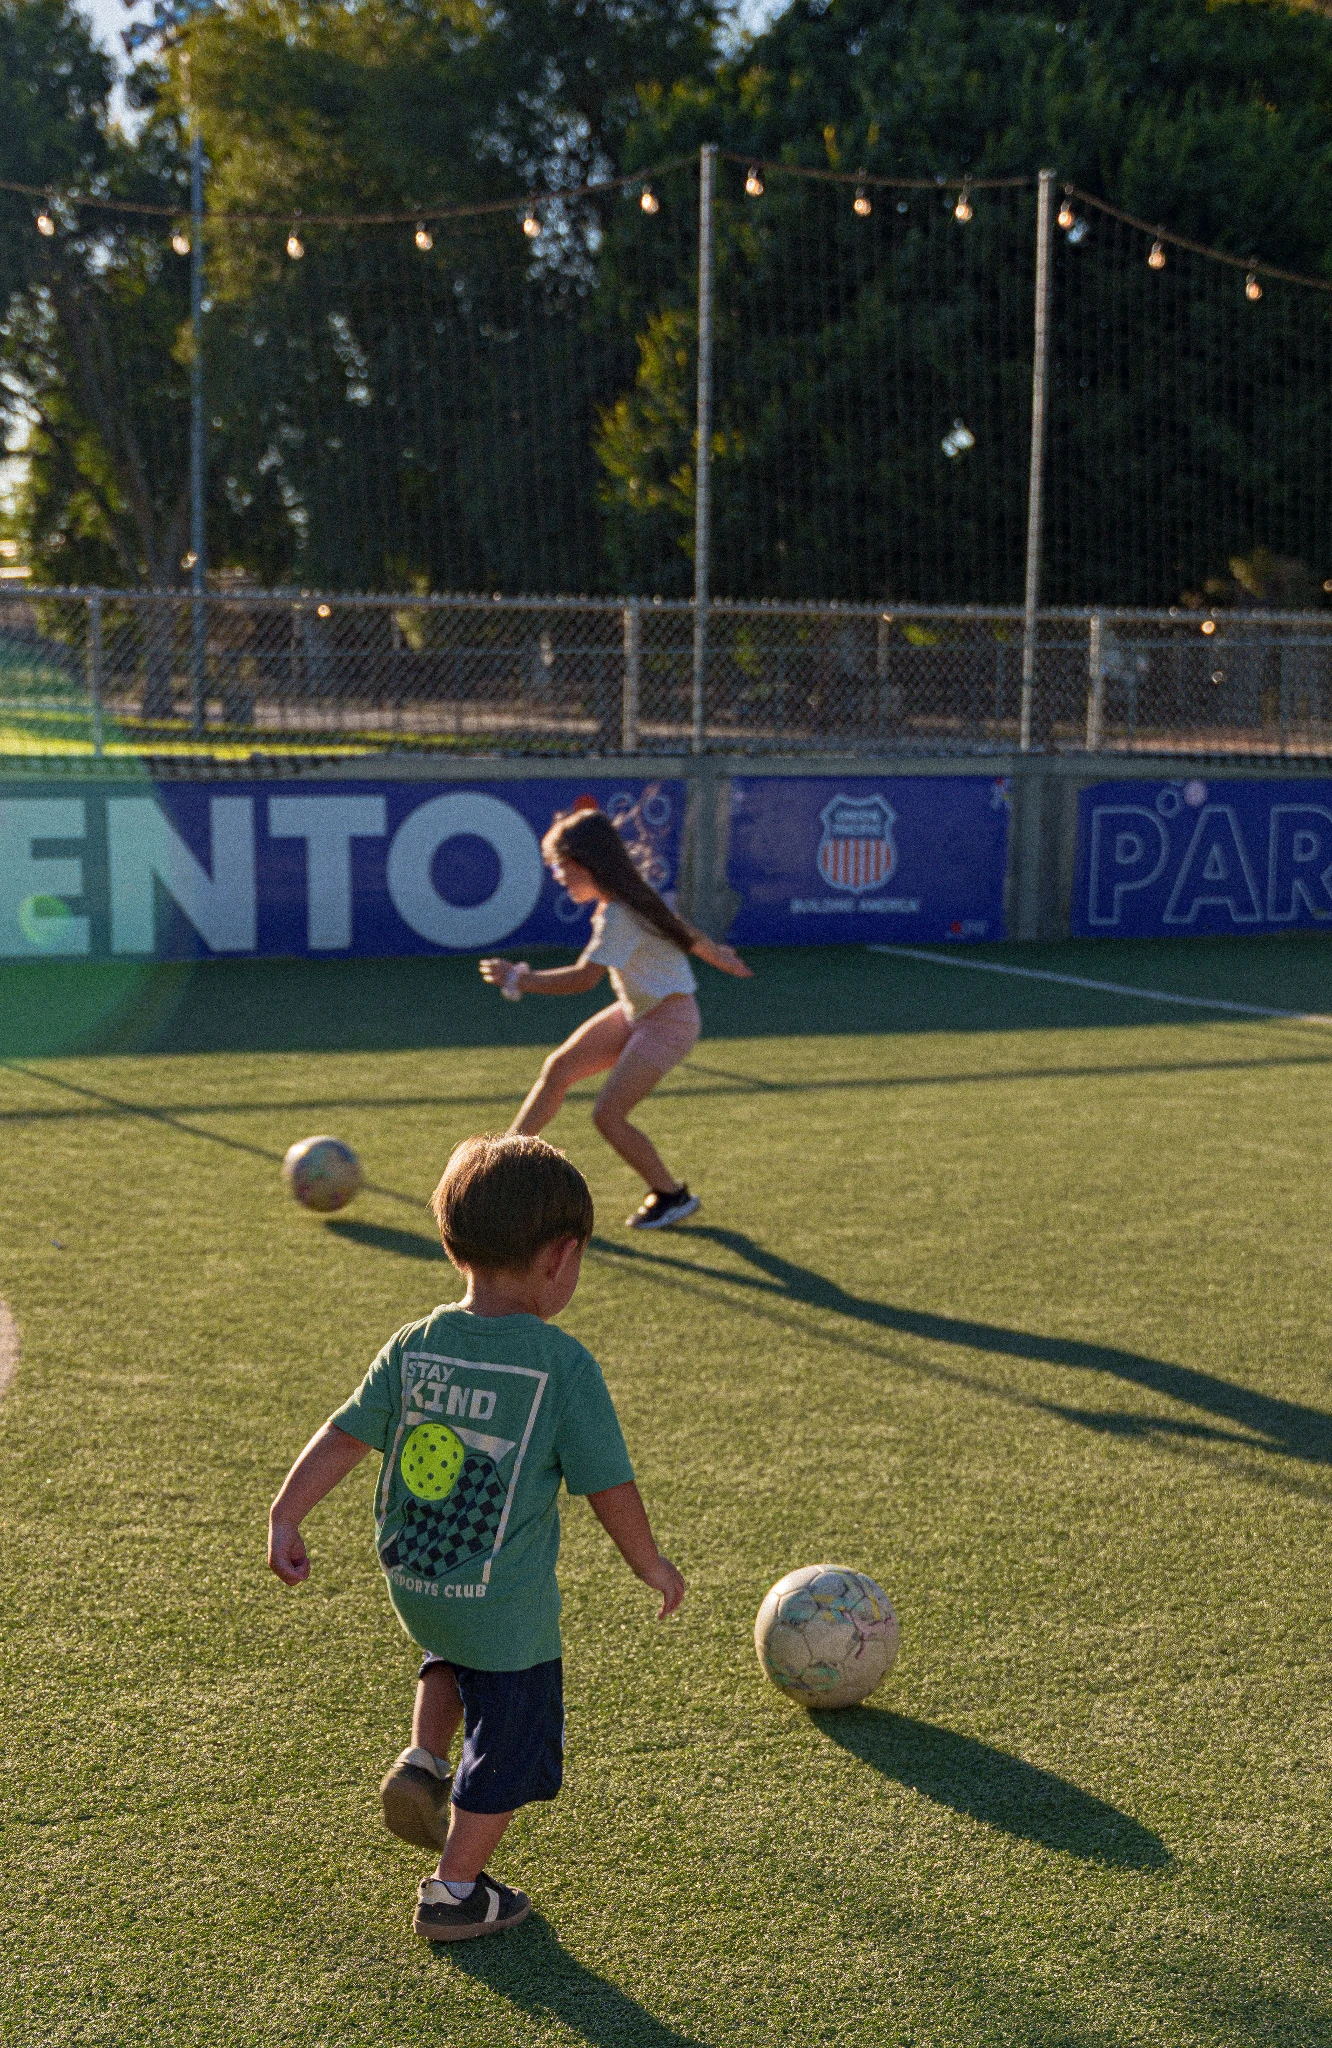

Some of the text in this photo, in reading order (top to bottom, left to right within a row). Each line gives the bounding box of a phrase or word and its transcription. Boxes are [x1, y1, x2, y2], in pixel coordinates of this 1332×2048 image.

[0, 792, 543, 954] ENTO
[1088, 803, 1332, 925] PAR
[407, 1361, 454, 1382] STAY
[407, 1380, 497, 1420] KIND
[393, 1572, 487, 1598] SPORTS CLUB
